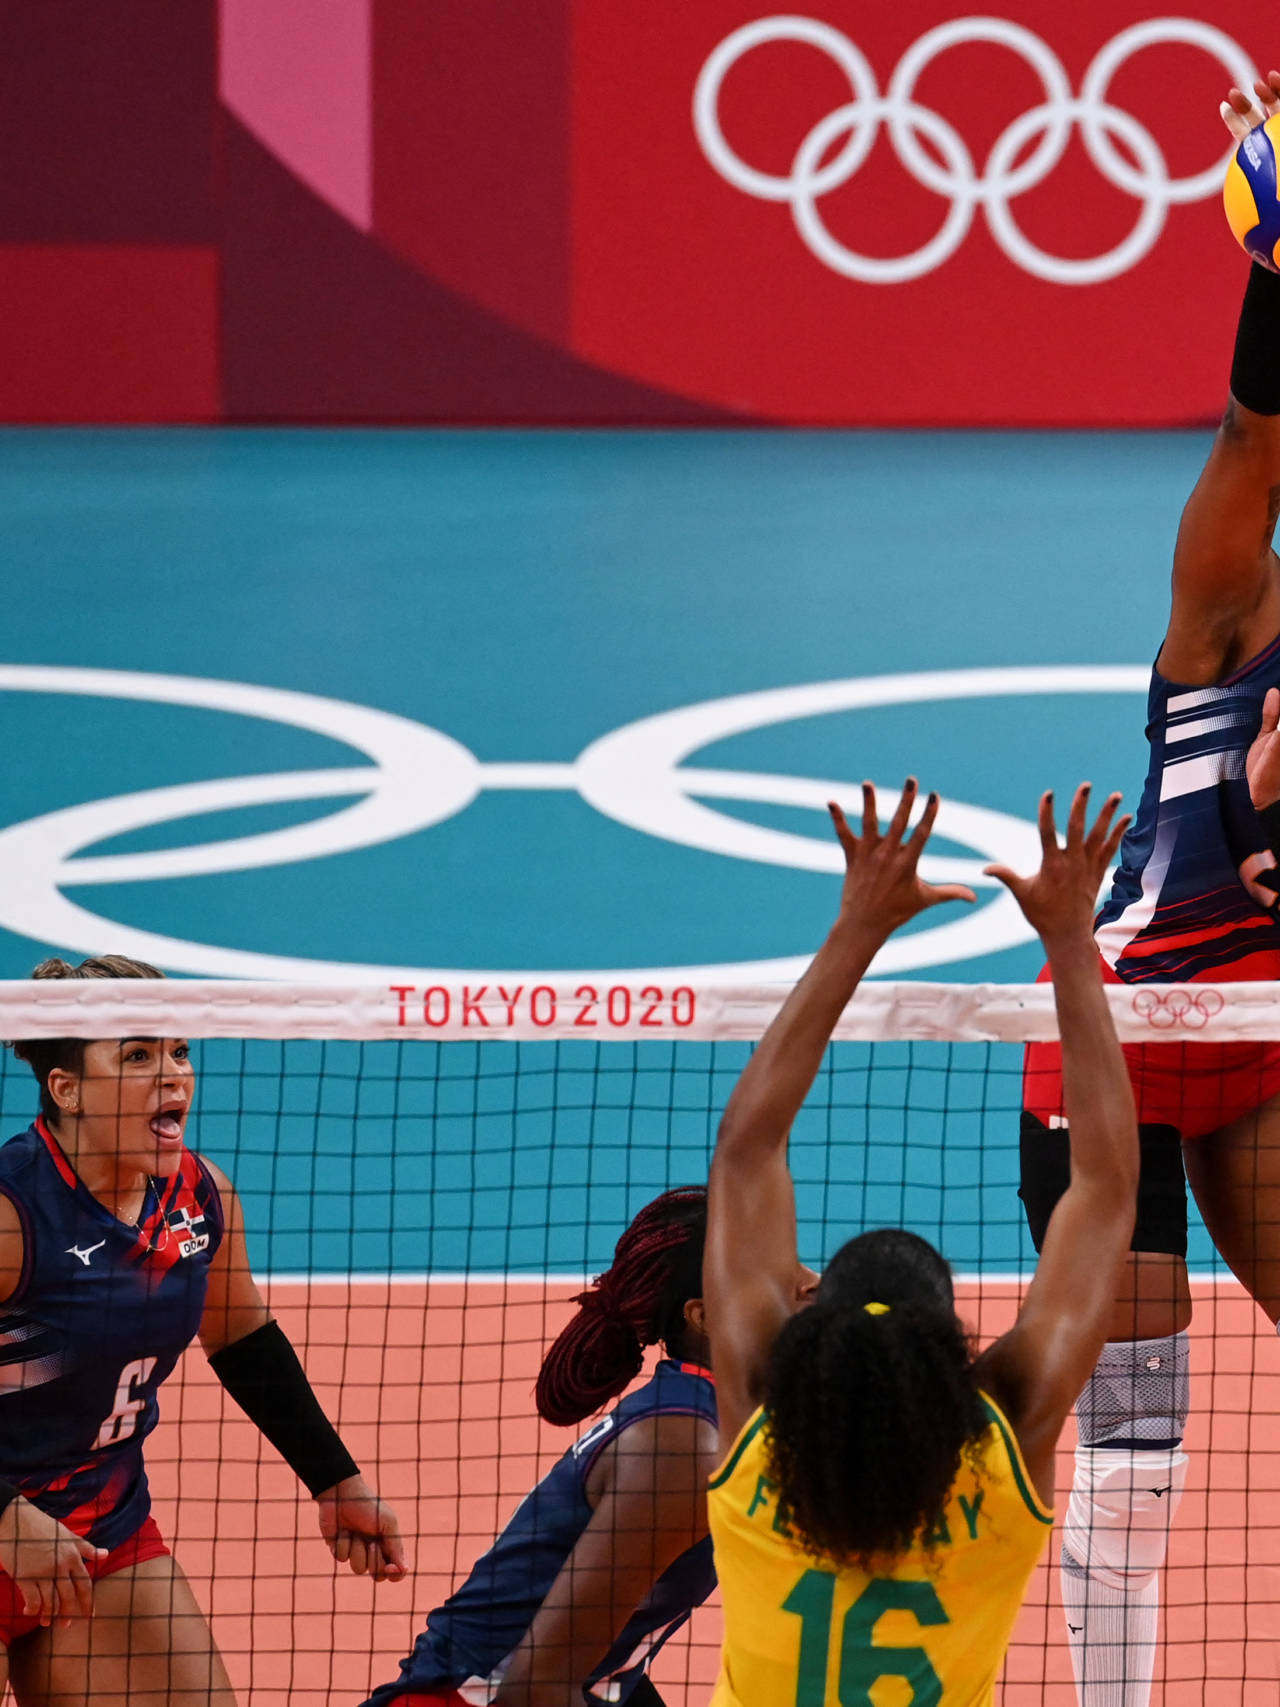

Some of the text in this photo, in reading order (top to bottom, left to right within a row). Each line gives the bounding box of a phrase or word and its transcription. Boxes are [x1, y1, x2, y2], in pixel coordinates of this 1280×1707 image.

[389, 985, 696, 1027] TOKYO 2020
[780, 1568, 950, 1707] 16
